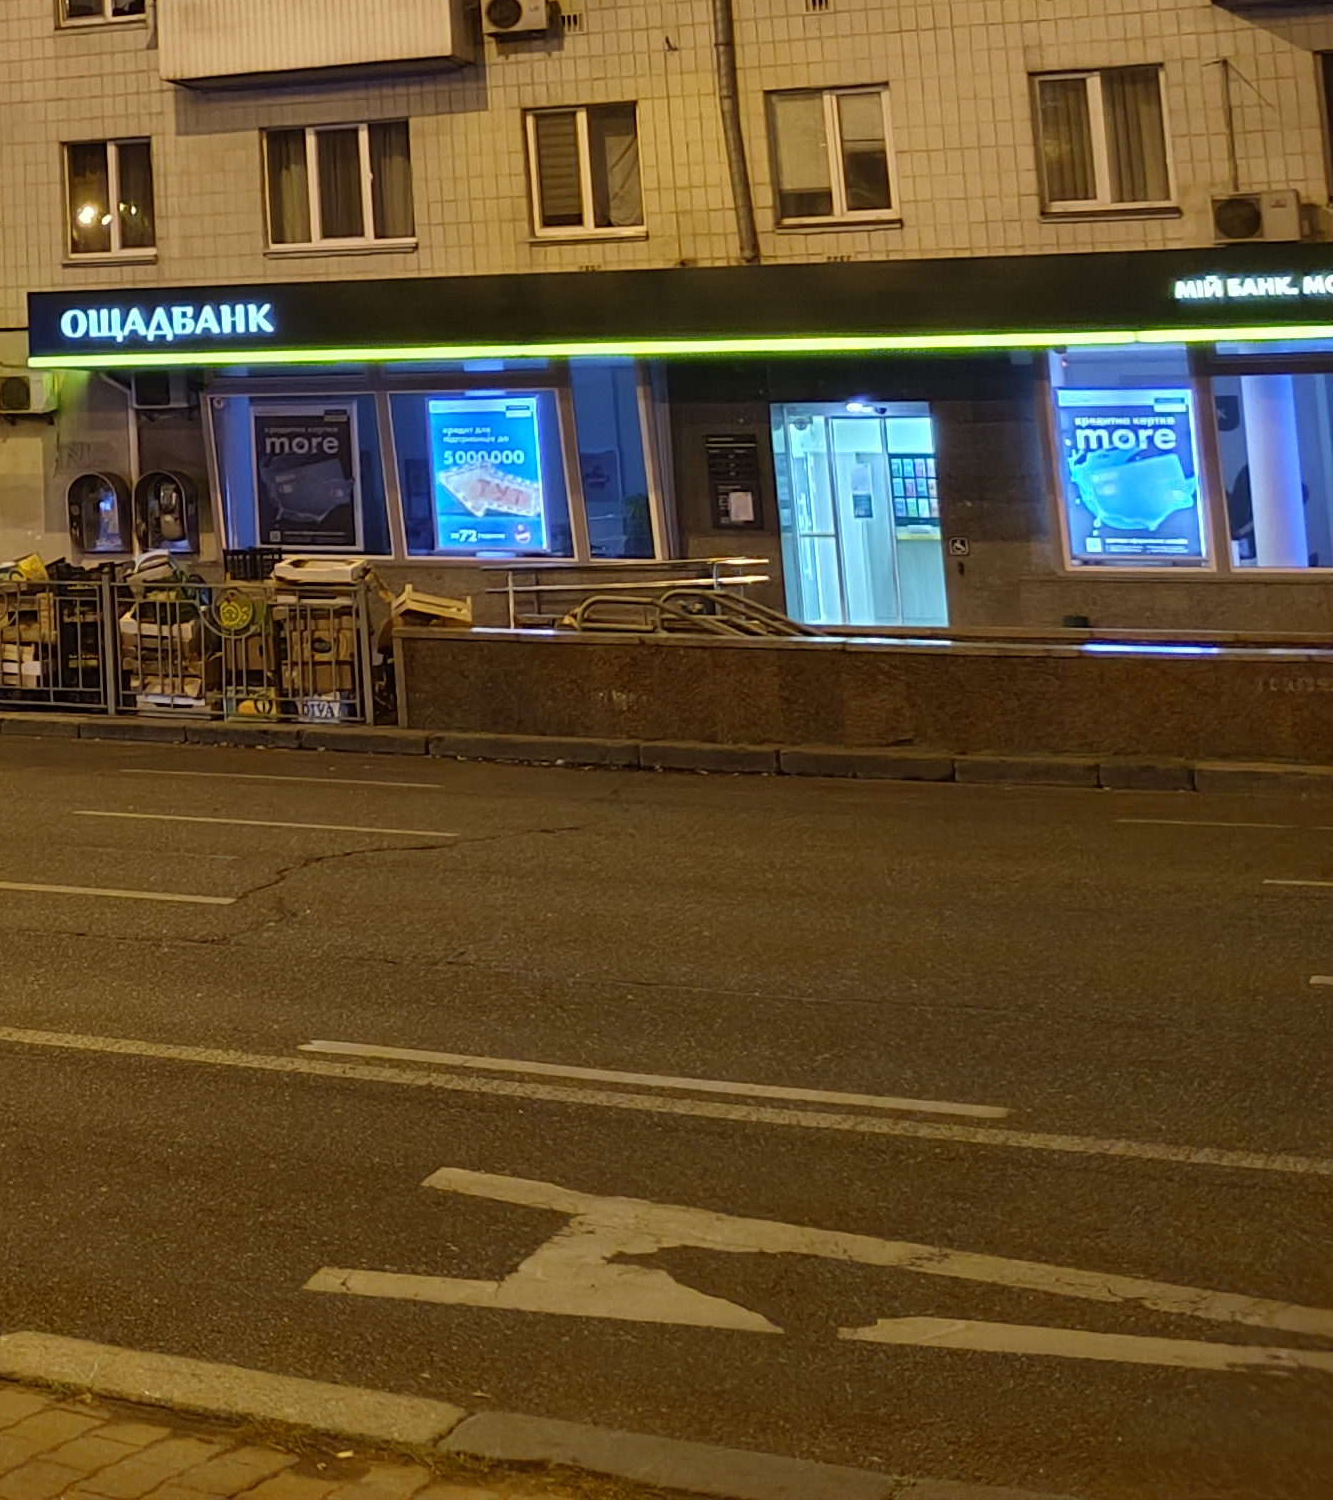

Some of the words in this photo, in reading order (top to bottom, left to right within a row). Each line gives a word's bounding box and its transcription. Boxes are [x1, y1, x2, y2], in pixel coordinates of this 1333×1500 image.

[1174, 275, 1224, 299] МІЙ
[59, 302, 276, 343] ОЩАДБАНК
[264, 436, 340, 455] more
[1075, 427, 1177, 450] more
